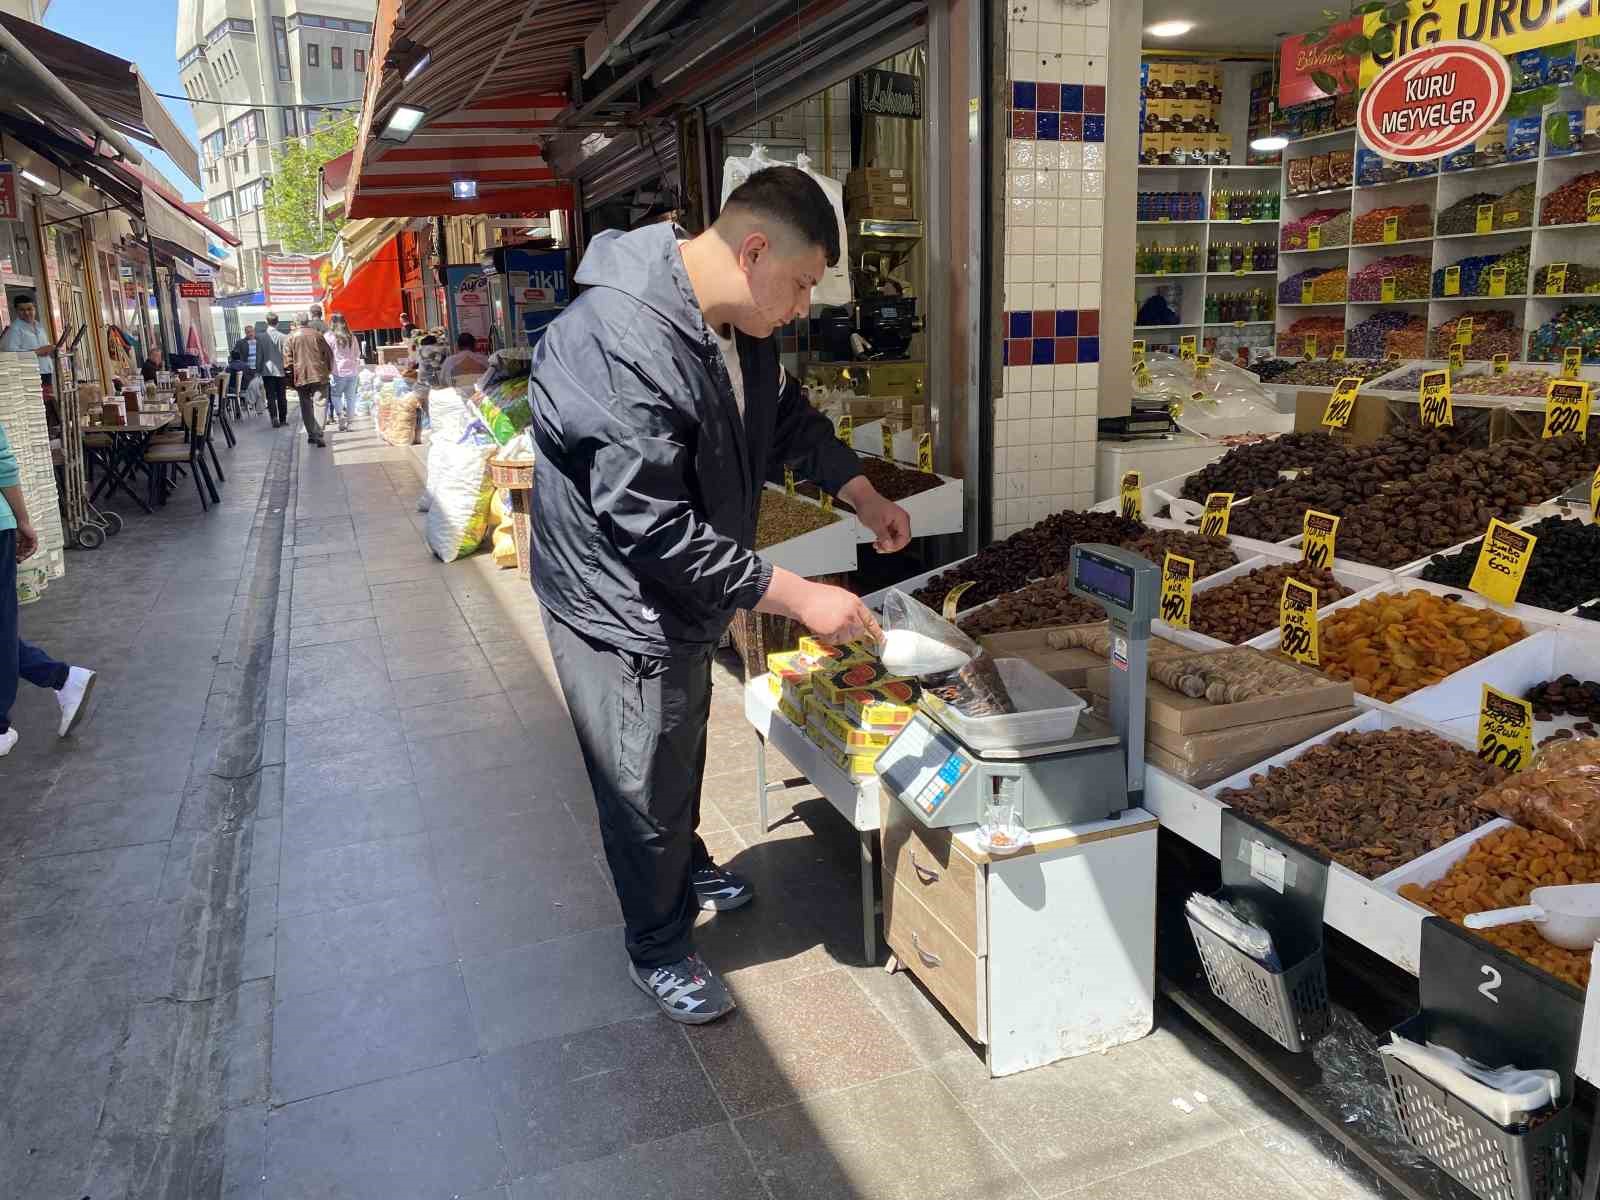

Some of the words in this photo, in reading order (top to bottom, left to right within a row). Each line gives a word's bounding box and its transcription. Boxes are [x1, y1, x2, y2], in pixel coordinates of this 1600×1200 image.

[1405, 72, 1457, 103] KURU
[1381, 99, 1477, 135] MEYVELER
[1478, 964, 1502, 1004] 2
